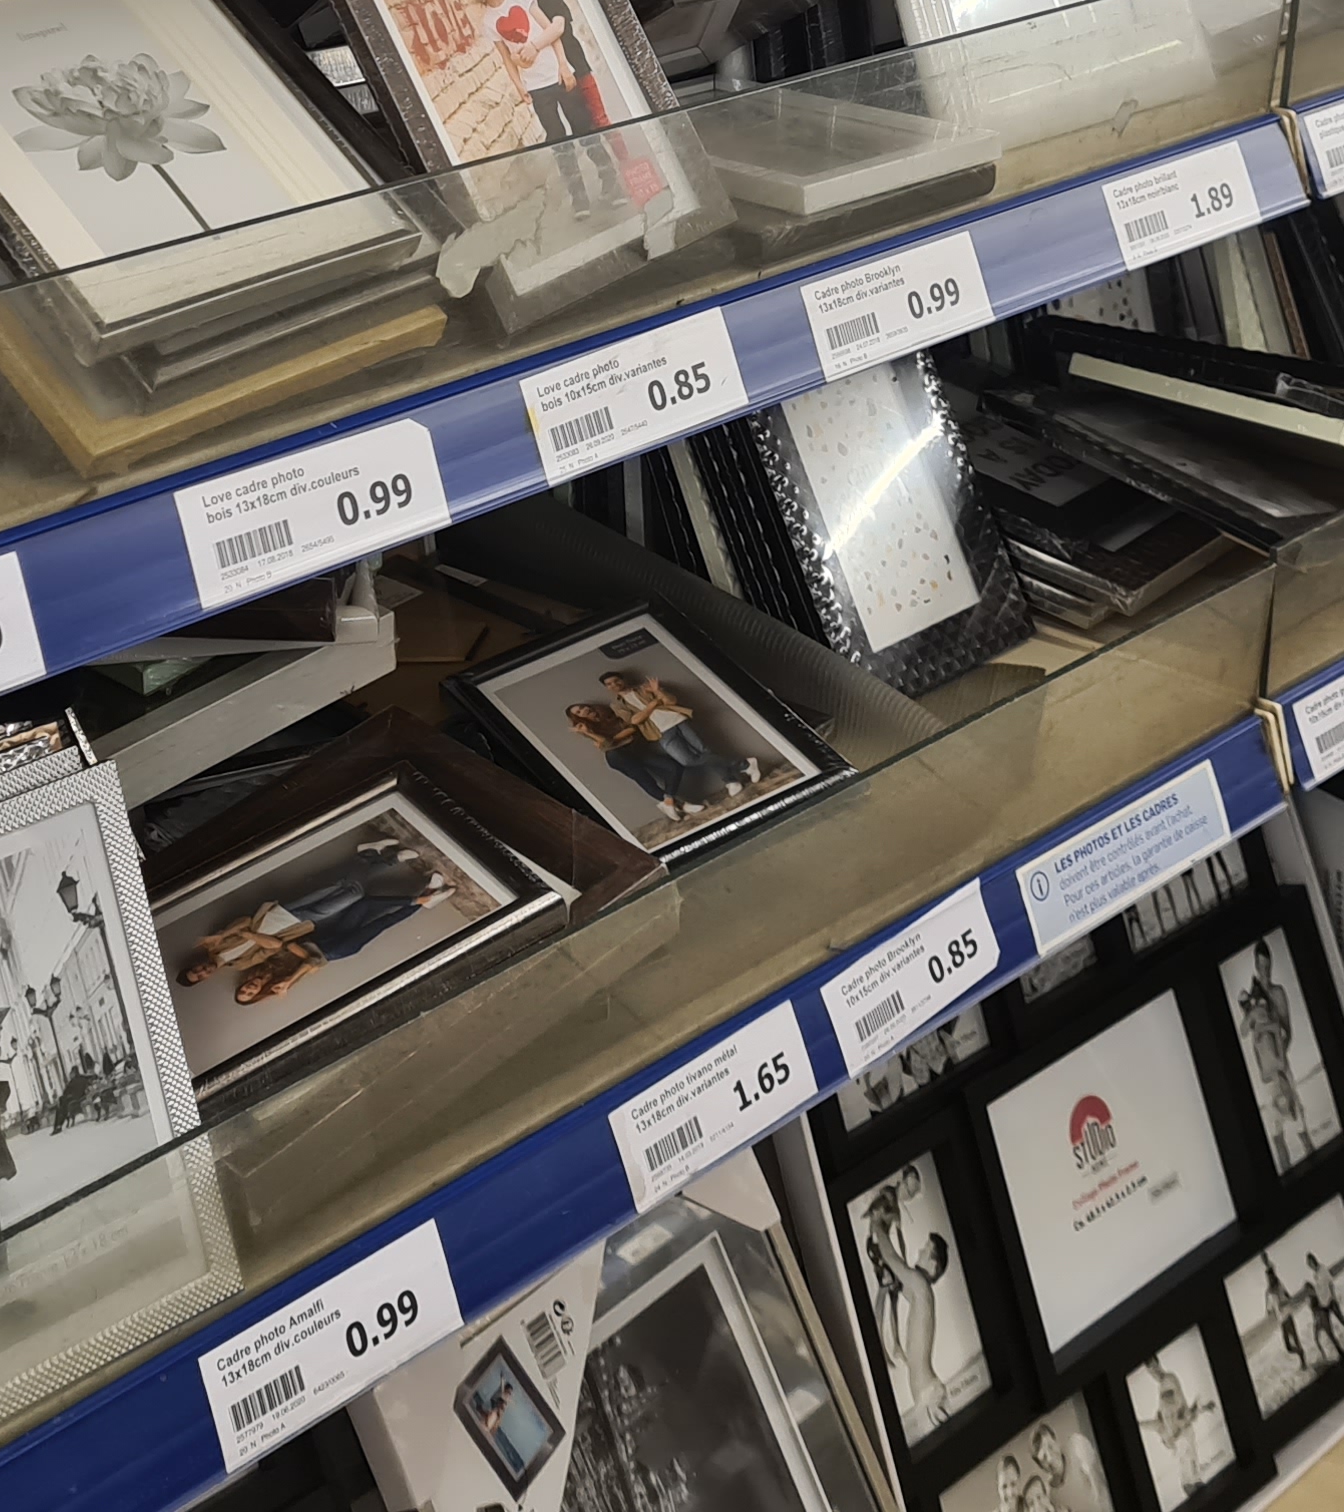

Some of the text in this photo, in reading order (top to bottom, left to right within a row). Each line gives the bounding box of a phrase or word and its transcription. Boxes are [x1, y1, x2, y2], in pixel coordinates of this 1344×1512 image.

[1113, 187, 1133, 199] Cadre
[1134, 178, 1154, 193] photo
[1190, 182, 1234, 219] 1.89
[814, 263, 901, 301] Cadre photo Brooklyn
[818, 277, 905, 314] 13x18cm div.variantes
[907, 277, 960, 320] 0.99
[536, 359, 620, 398] Love cadre photo
[541, 355, 668, 412] bois 10x15cm div.variantes
[647, 361, 712, 411] 0.85
[201, 466, 305, 508] Love cadre photo
[205, 465, 361, 524] bois 13x18cm div.couleurs
[336, 472, 413, 527] 0.99
[1054, 793, 1179, 874] LES PHOTOS ET LES CADRES
[1063, 891, 1084, 906] Pour
[841, 932, 921, 996] Cadre photo Brooklyn
[927, 927, 978, 984] 0.85
[845, 980, 879, 1009] 10x15cm
[630, 1045, 739, 1121] Cadre photo tivano métal
[635, 1067, 730, 1135] 13x18cm div.variantes
[733, 1051, 790, 1112] 1.65
[1072, 1120, 1118, 1170] STUDIO
[216, 1298, 326, 1372] Cadre photo Amalfi
[220, 1308, 342, 1388] 13x18cm div.couleurs
[345, 1288, 419, 1358] 0.99
